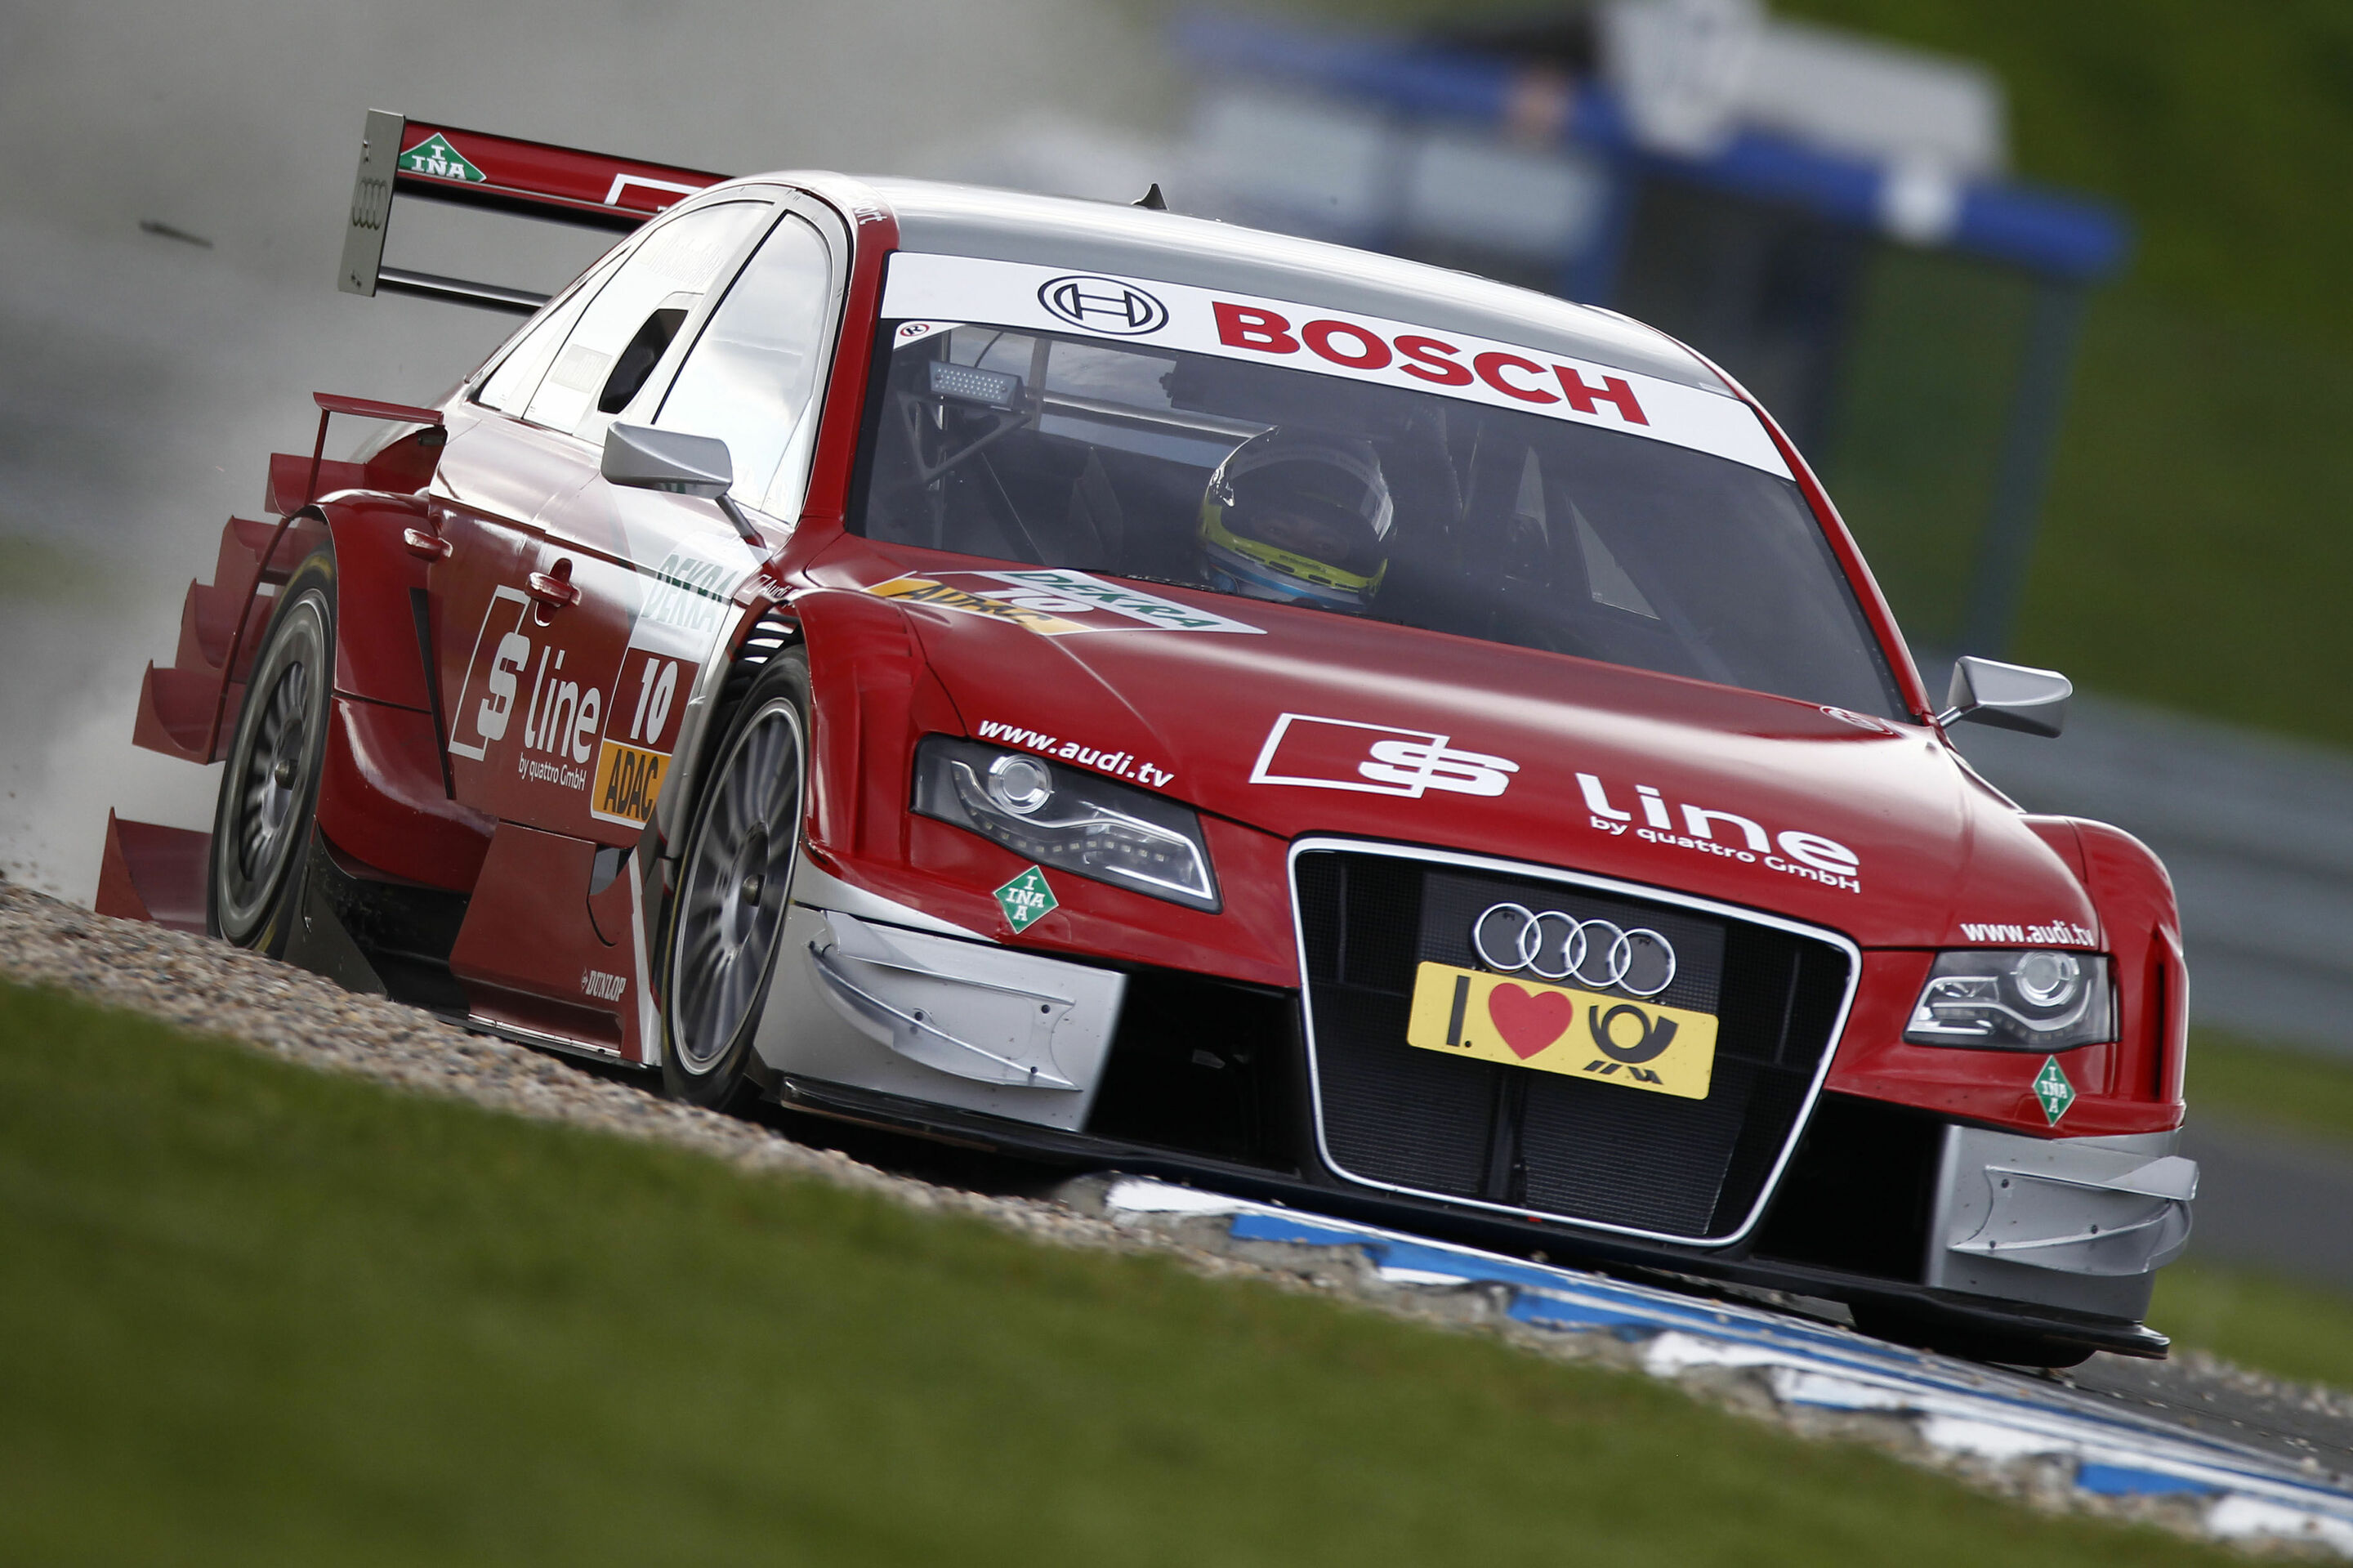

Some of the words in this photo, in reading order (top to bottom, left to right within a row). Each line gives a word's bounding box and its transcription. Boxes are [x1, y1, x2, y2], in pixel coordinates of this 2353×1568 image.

[1212, 301, 1650, 427] BOSCH
[975, 590, 1095, 612] 10
[999, 573, 1222, 628] DEKRA
[525, 646, 601, 764] line
[630, 657, 678, 745] 10
[519, 751, 530, 780] by
[529, 761, 559, 784] quattro
[560, 765, 587, 791] GmbH
[603, 748, 659, 822] ADAC
[979, 719, 1175, 788] www.audi.tv
[1575, 772, 1860, 878] line
[1589, 815, 1628, 835] by
[1636, 824, 1757, 864] quattro
[1763, 855, 1862, 895] GmbH
[1960, 919, 2095, 947] www.audi.tv
[585, 970, 627, 1003] DUNLOP
